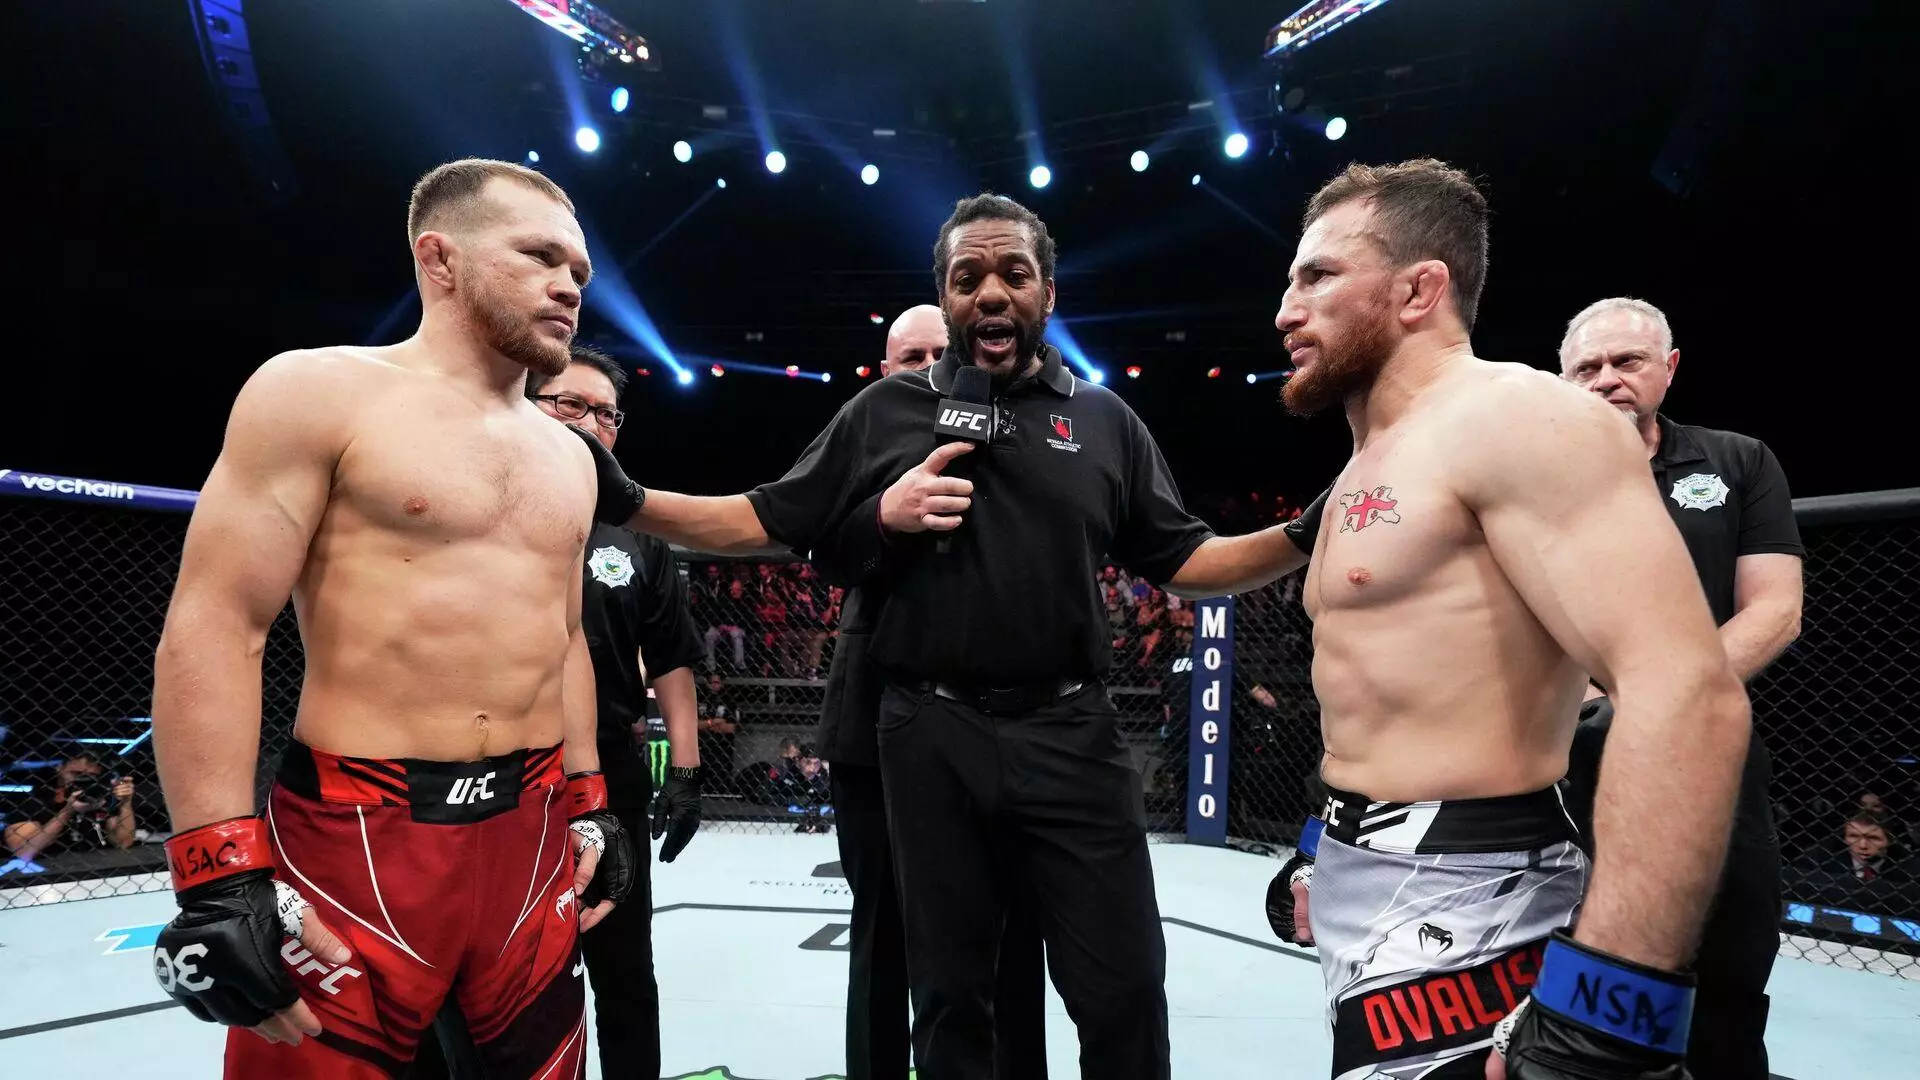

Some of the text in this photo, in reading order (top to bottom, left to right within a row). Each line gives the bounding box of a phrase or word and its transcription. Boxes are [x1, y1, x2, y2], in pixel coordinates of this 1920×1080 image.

[939, 408, 987, 431] UFC
[20, 475, 134, 500] vechain
[1198, 606, 1227, 818] Modelo
[446, 771, 496, 805] UFC
[748, 880, 848, 888] EXCLUSIV
[279, 894, 300, 915] UFC
[280, 938, 363, 996] UFC
